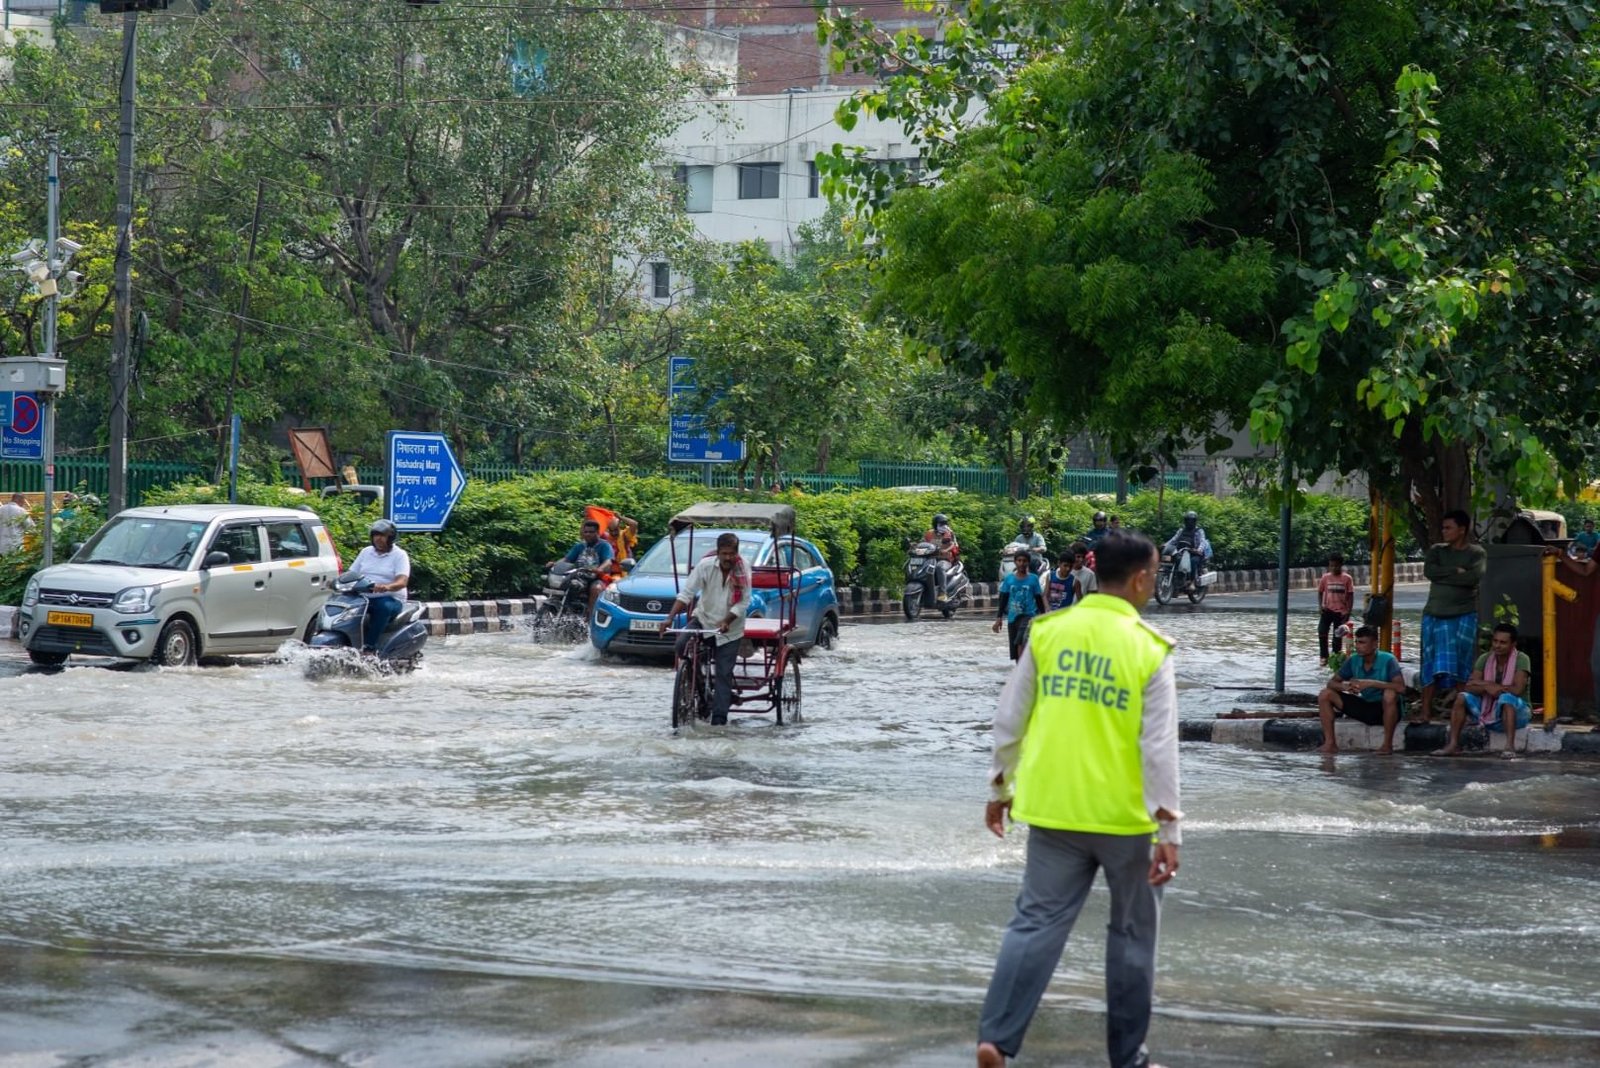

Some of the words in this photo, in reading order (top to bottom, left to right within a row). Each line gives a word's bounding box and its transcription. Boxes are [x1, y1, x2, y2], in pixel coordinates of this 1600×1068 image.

[13, 437, 40, 447] Stopping
[427, 442, 440, 455] मार्ग
[672, 442, 690, 451] Marg
[396, 459, 425, 472] Nishadraj
[425, 460, 440, 472] Marg
[1058, 649, 1115, 681] CIVIL
